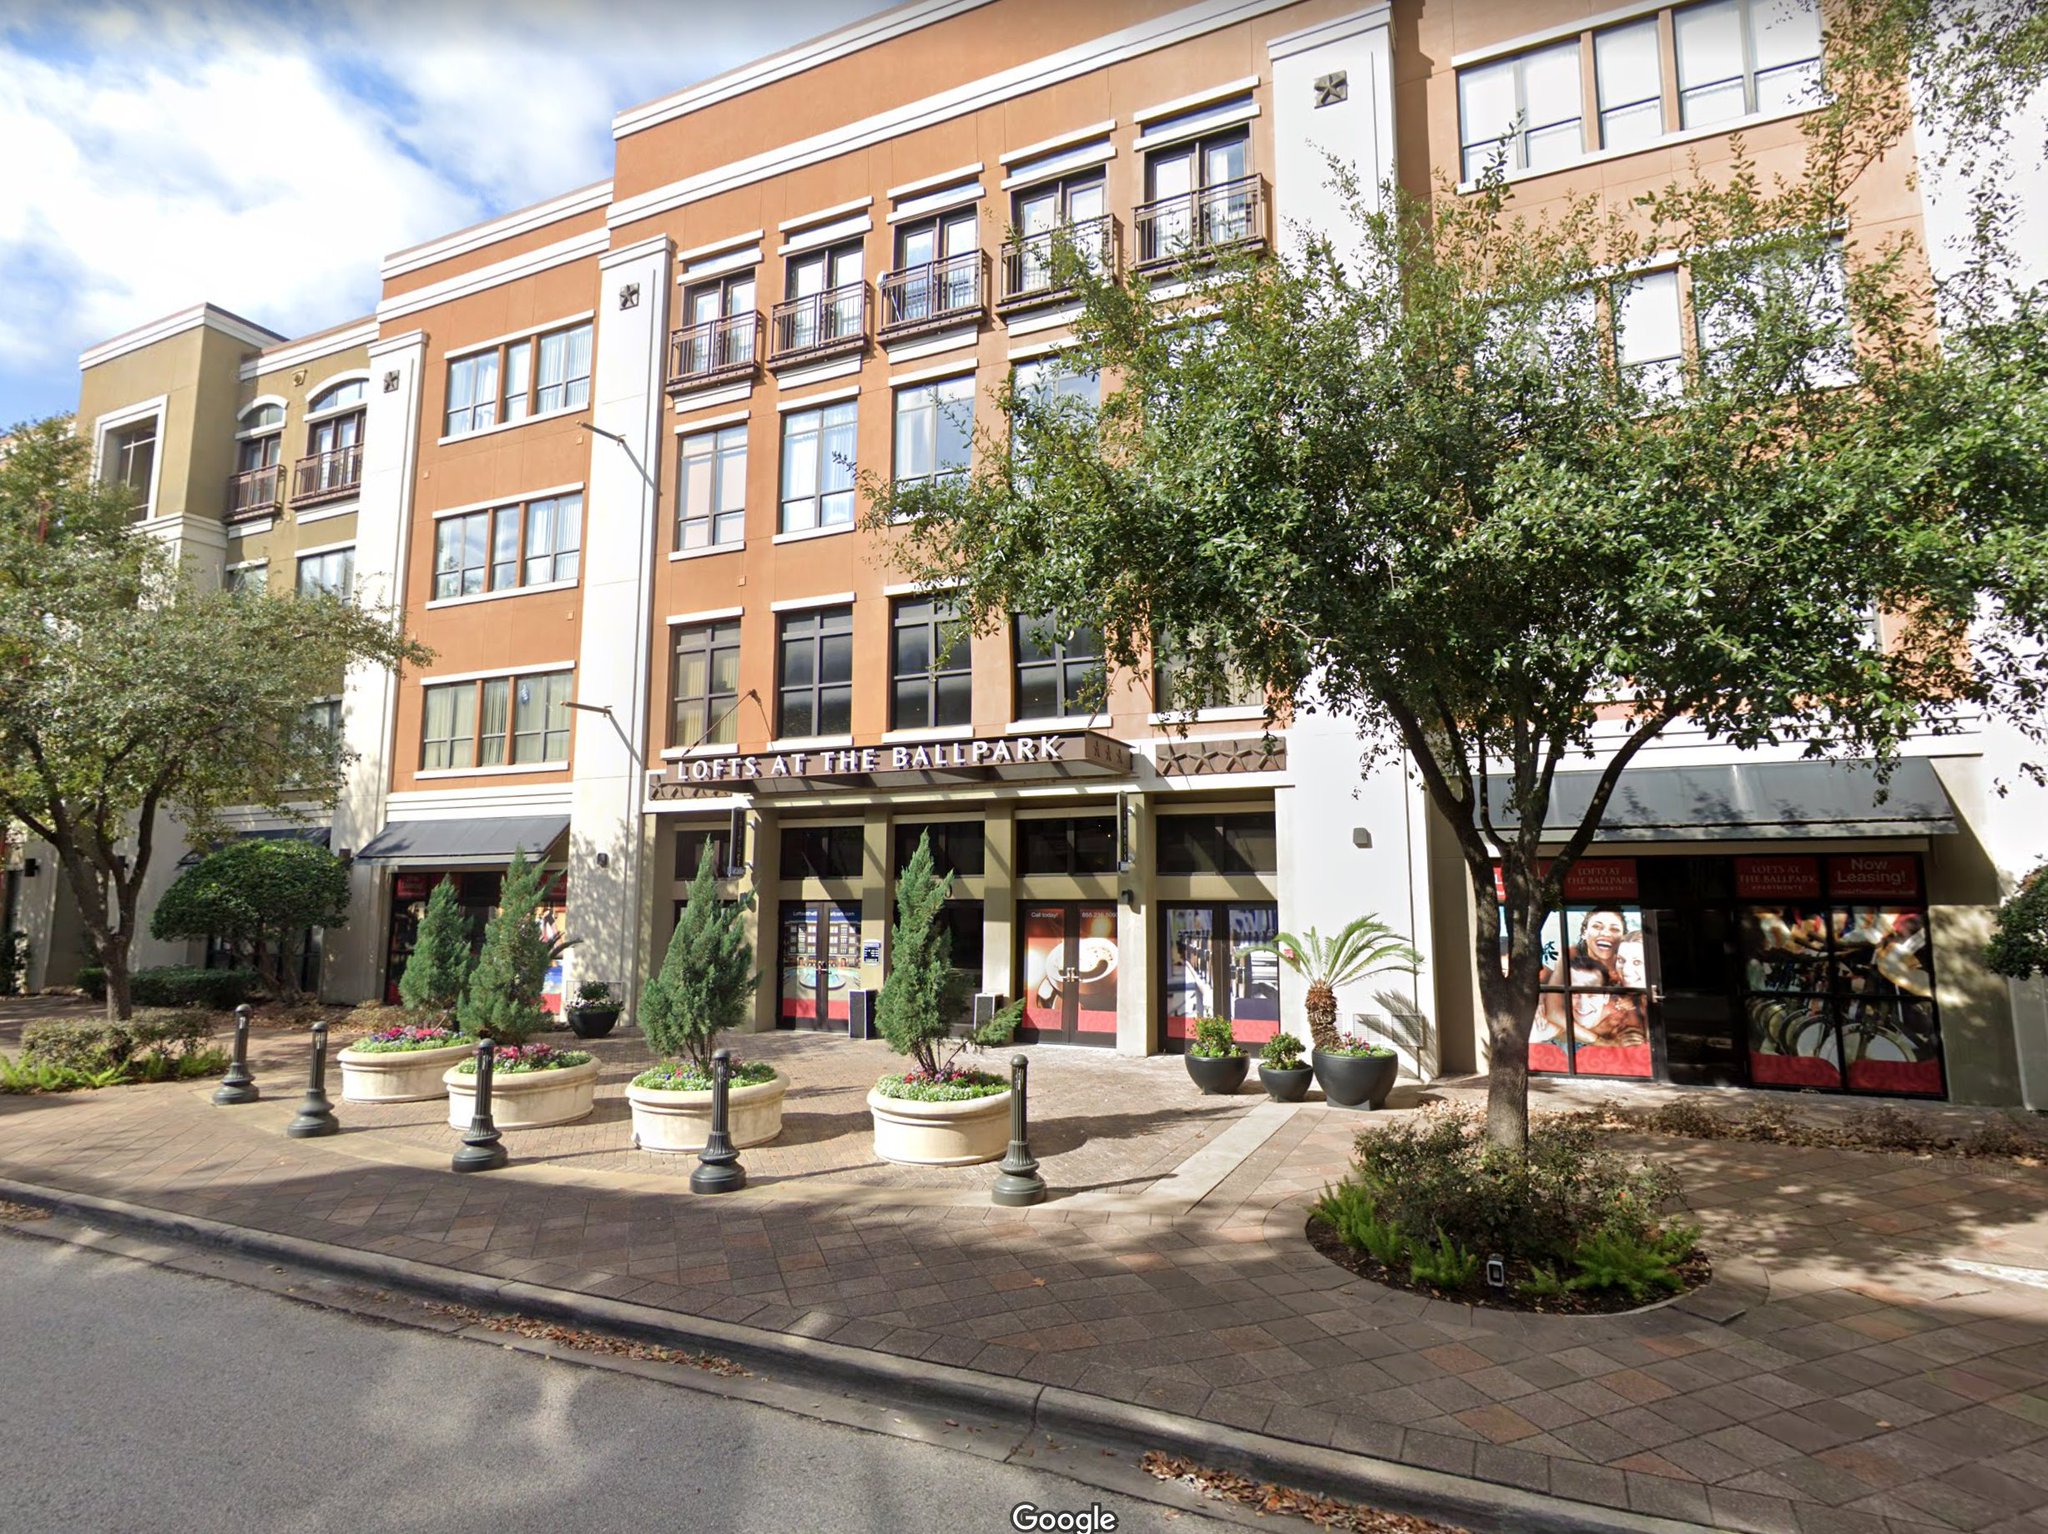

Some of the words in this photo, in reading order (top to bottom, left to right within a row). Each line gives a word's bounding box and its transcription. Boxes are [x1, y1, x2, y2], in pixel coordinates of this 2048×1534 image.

[677, 756, 757, 780] LOFTS
[771, 753, 805, 775] AT
[820, 749, 875, 772] THE
[892, 735, 1060, 767] BALLPARK
[1751, 864, 1785, 874] LOFTS
[1851, 859, 1888, 871] Now
[1578, 867, 1607, 876] LOFTS
[1609, 867, 1621, 876] AT
[1567, 876, 1587, 885] THE
[1588, 876, 1635, 885] BALLPARK
[1763, 874, 1816, 883] BALLPARK
[1837, 869, 1907, 886] Leasing!
